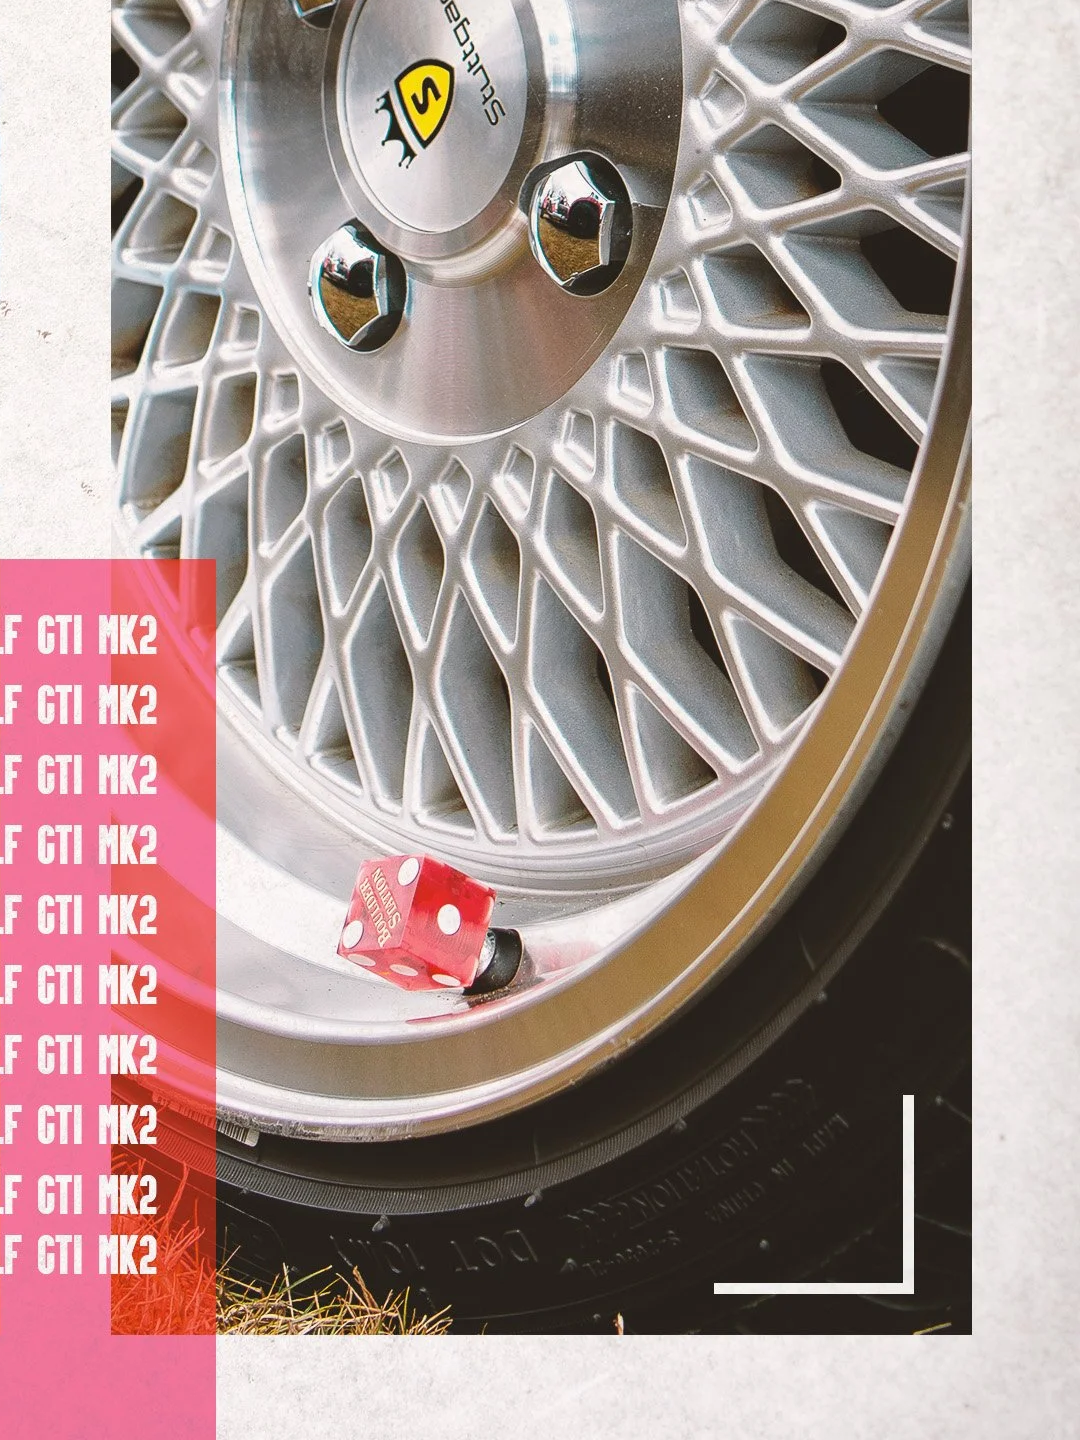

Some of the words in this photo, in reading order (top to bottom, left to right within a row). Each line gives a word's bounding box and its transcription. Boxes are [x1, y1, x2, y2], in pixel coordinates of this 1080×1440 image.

[359, 877, 393, 948] BOULDER
[371, 868, 402, 931] STATION
[450, 1229, 539, 1272] DOT
